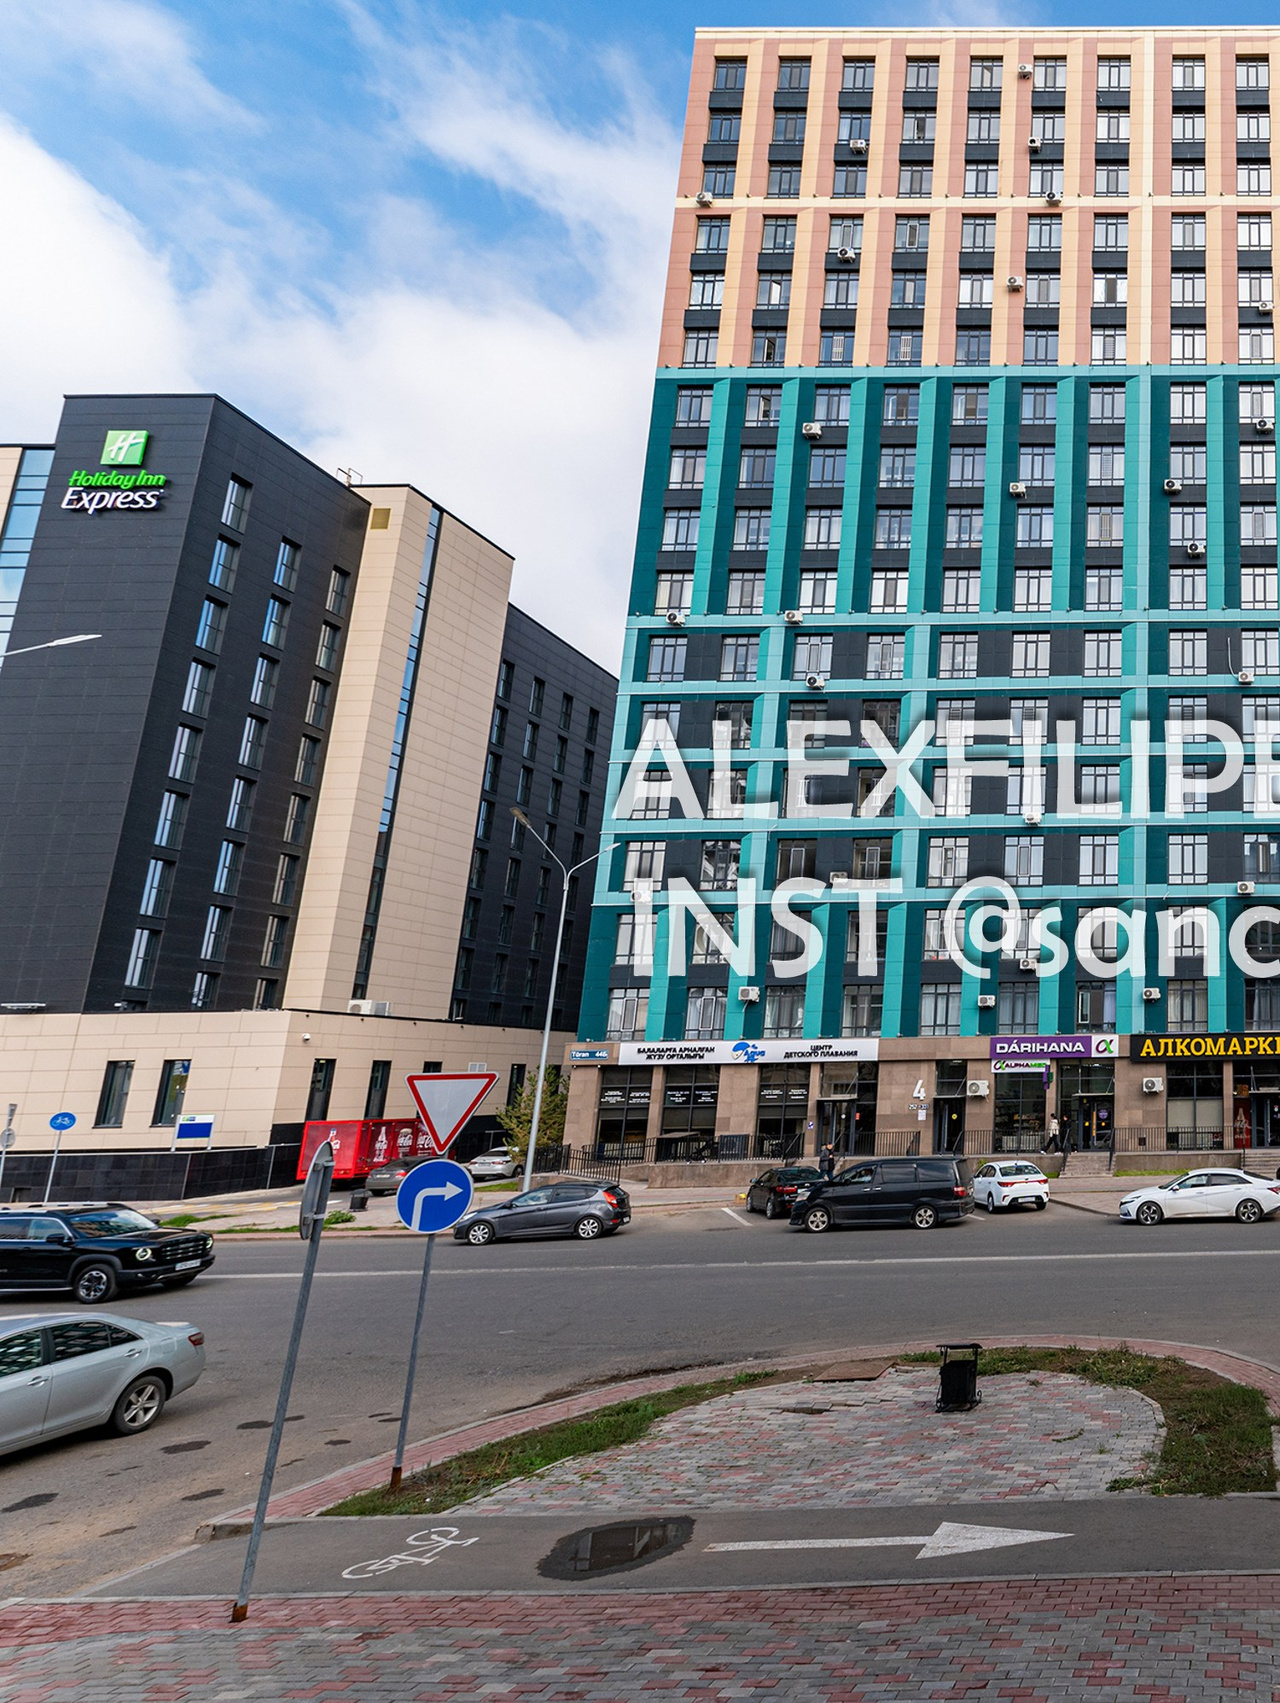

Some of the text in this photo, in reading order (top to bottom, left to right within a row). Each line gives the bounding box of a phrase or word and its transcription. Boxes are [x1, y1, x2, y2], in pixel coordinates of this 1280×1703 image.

[68, 470, 167, 490] Holiday Inn
[61, 487, 161, 515] Express
[783, 1051, 819, 1059] ДЕТСКОГО
[995, 1039, 1085, 1054] DÁRIHANA
[912, 1079, 926, 1100] 4
